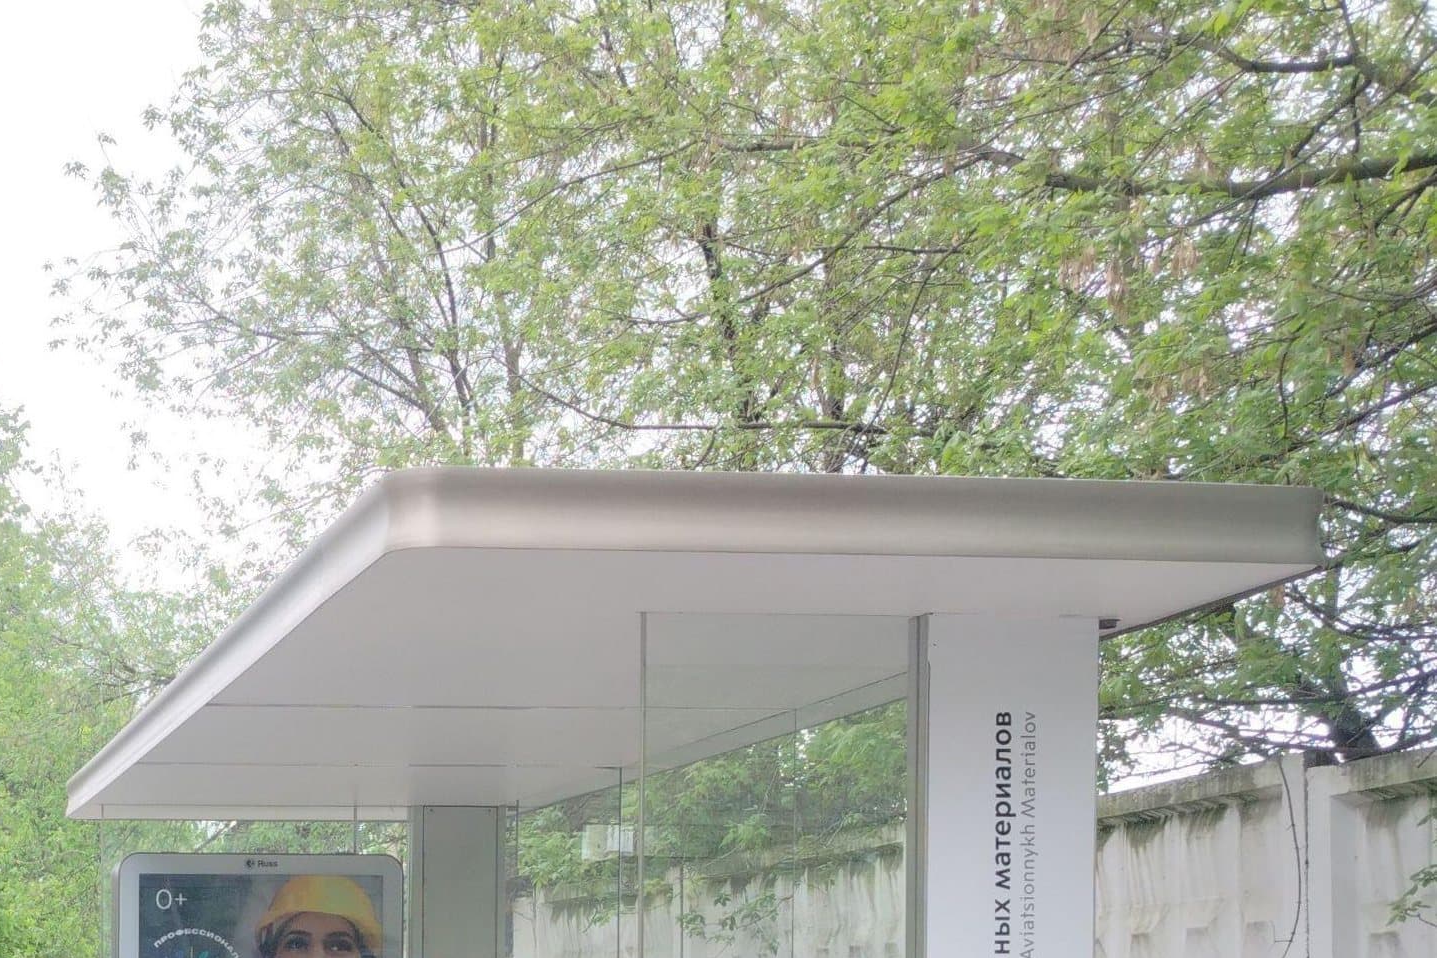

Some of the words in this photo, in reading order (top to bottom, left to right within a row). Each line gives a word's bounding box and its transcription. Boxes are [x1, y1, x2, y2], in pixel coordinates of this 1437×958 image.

[994, 711, 1016, 890] материалов
[1020, 711, 1036, 819] Materialov
[155, 889, 187, 910] 0+
